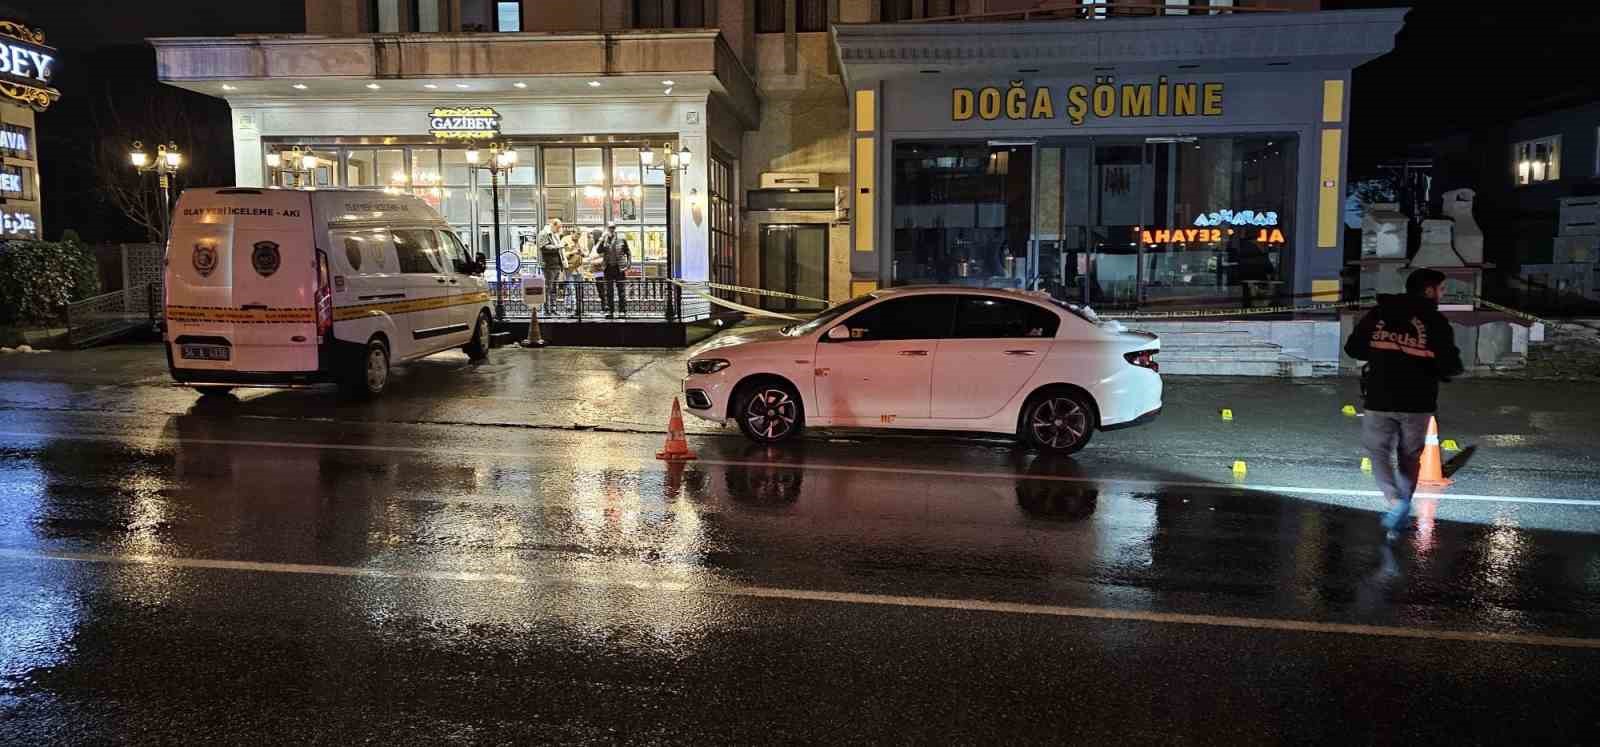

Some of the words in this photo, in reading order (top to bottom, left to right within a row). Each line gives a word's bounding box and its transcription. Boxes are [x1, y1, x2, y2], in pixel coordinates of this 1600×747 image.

[951, 79, 1055, 121] DOĞA
[1066, 76, 1225, 126] ŞÖMİNE
[431, 116, 495, 130] GAZİBEY
